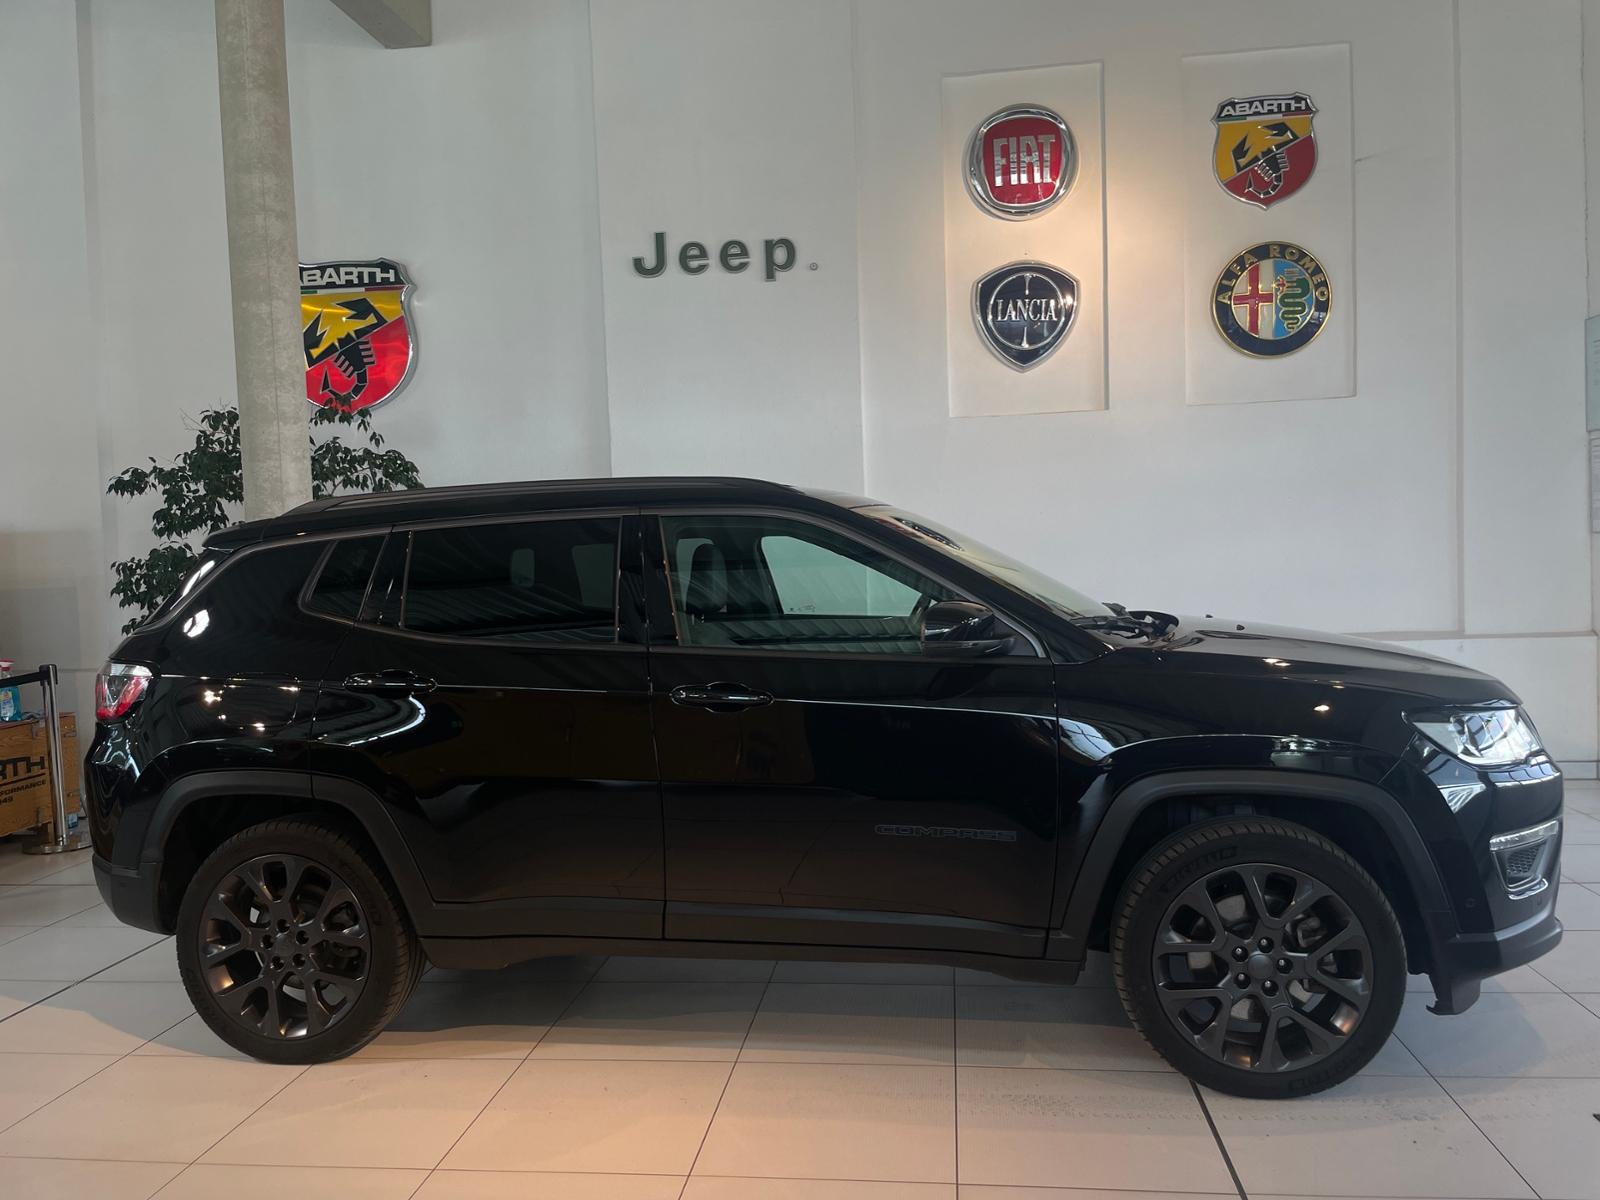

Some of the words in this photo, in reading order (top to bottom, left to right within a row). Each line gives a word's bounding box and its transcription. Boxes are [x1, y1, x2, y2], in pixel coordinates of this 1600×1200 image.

[1220, 100, 1306, 117] ABARTH
[993, 134, 1056, 187] FIAT
[300, 266, 395, 286] BARTH
[1216, 252, 1258, 305] ALFA
[1268, 244, 1329, 301] ROMEO
[995, 299, 1058, 322] LANCIA
[874, 824, 1017, 842] COMPASS
